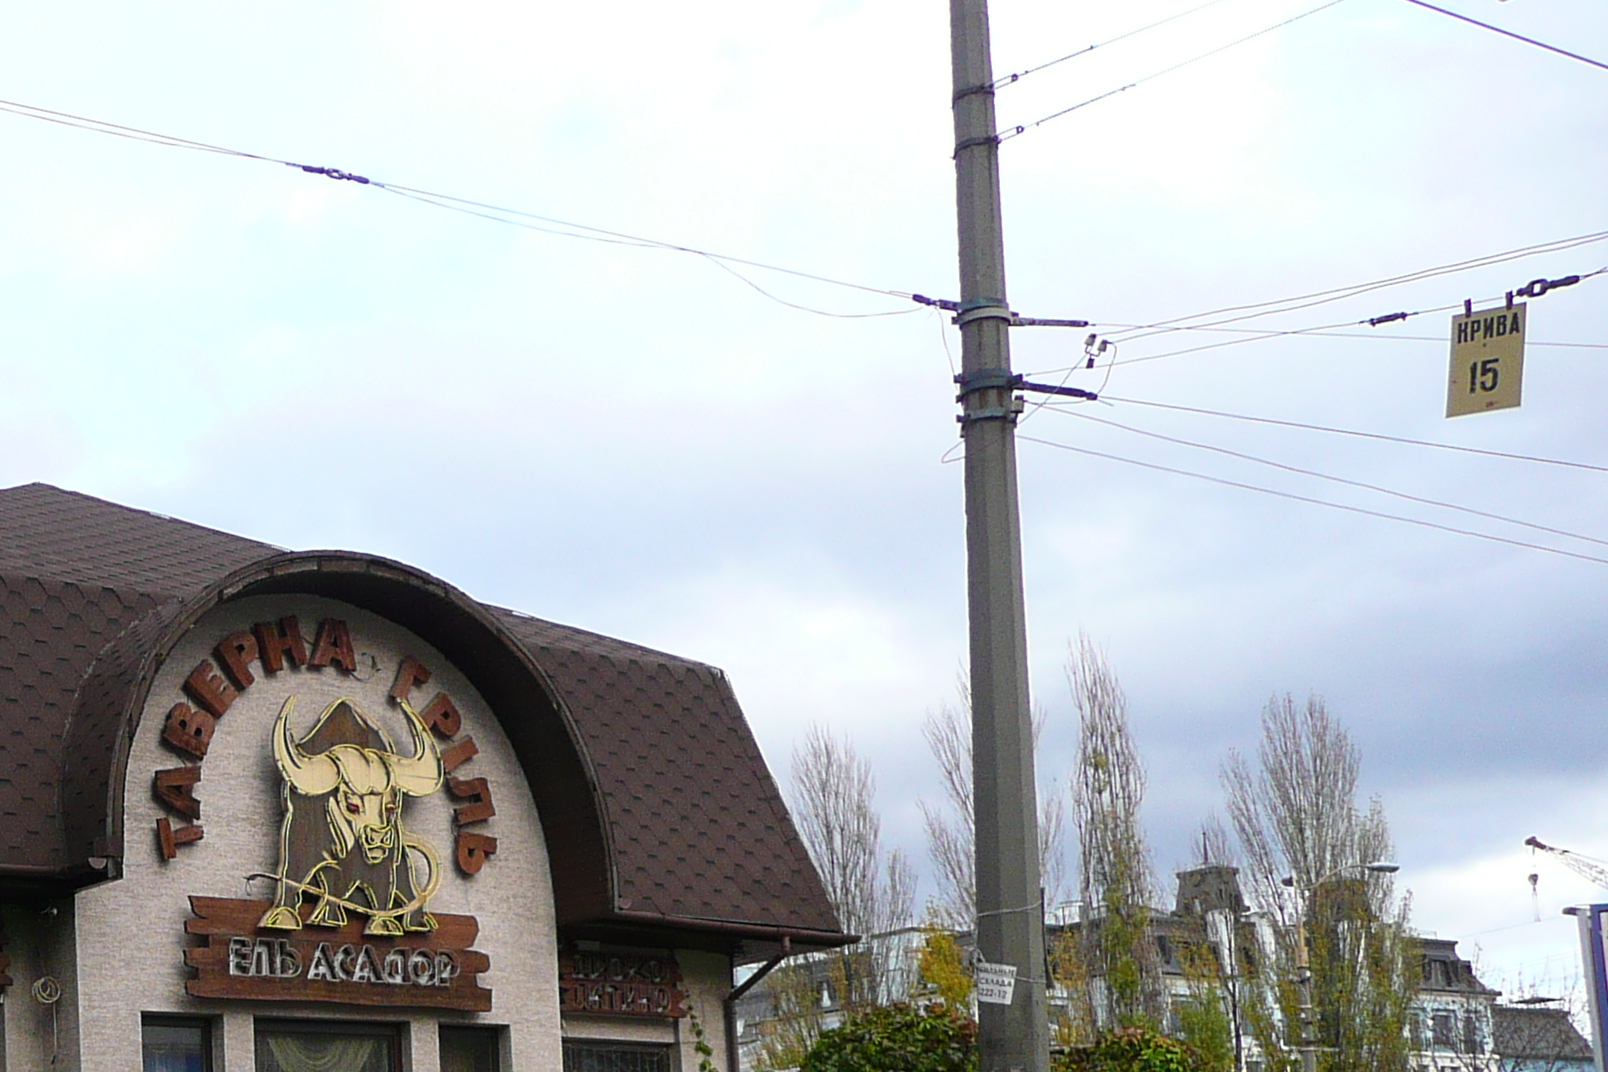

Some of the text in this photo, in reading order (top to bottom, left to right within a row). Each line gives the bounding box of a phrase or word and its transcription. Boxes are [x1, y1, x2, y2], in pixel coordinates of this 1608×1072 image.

[1457, 311, 1520, 344] КРИВА
[1468, 358, 1500, 394] 15
[155, 615, 497, 876] ТАВЕРНА ГРІЛЬ
[229, 937, 460, 987] ЕЛЬ АСАДОР
